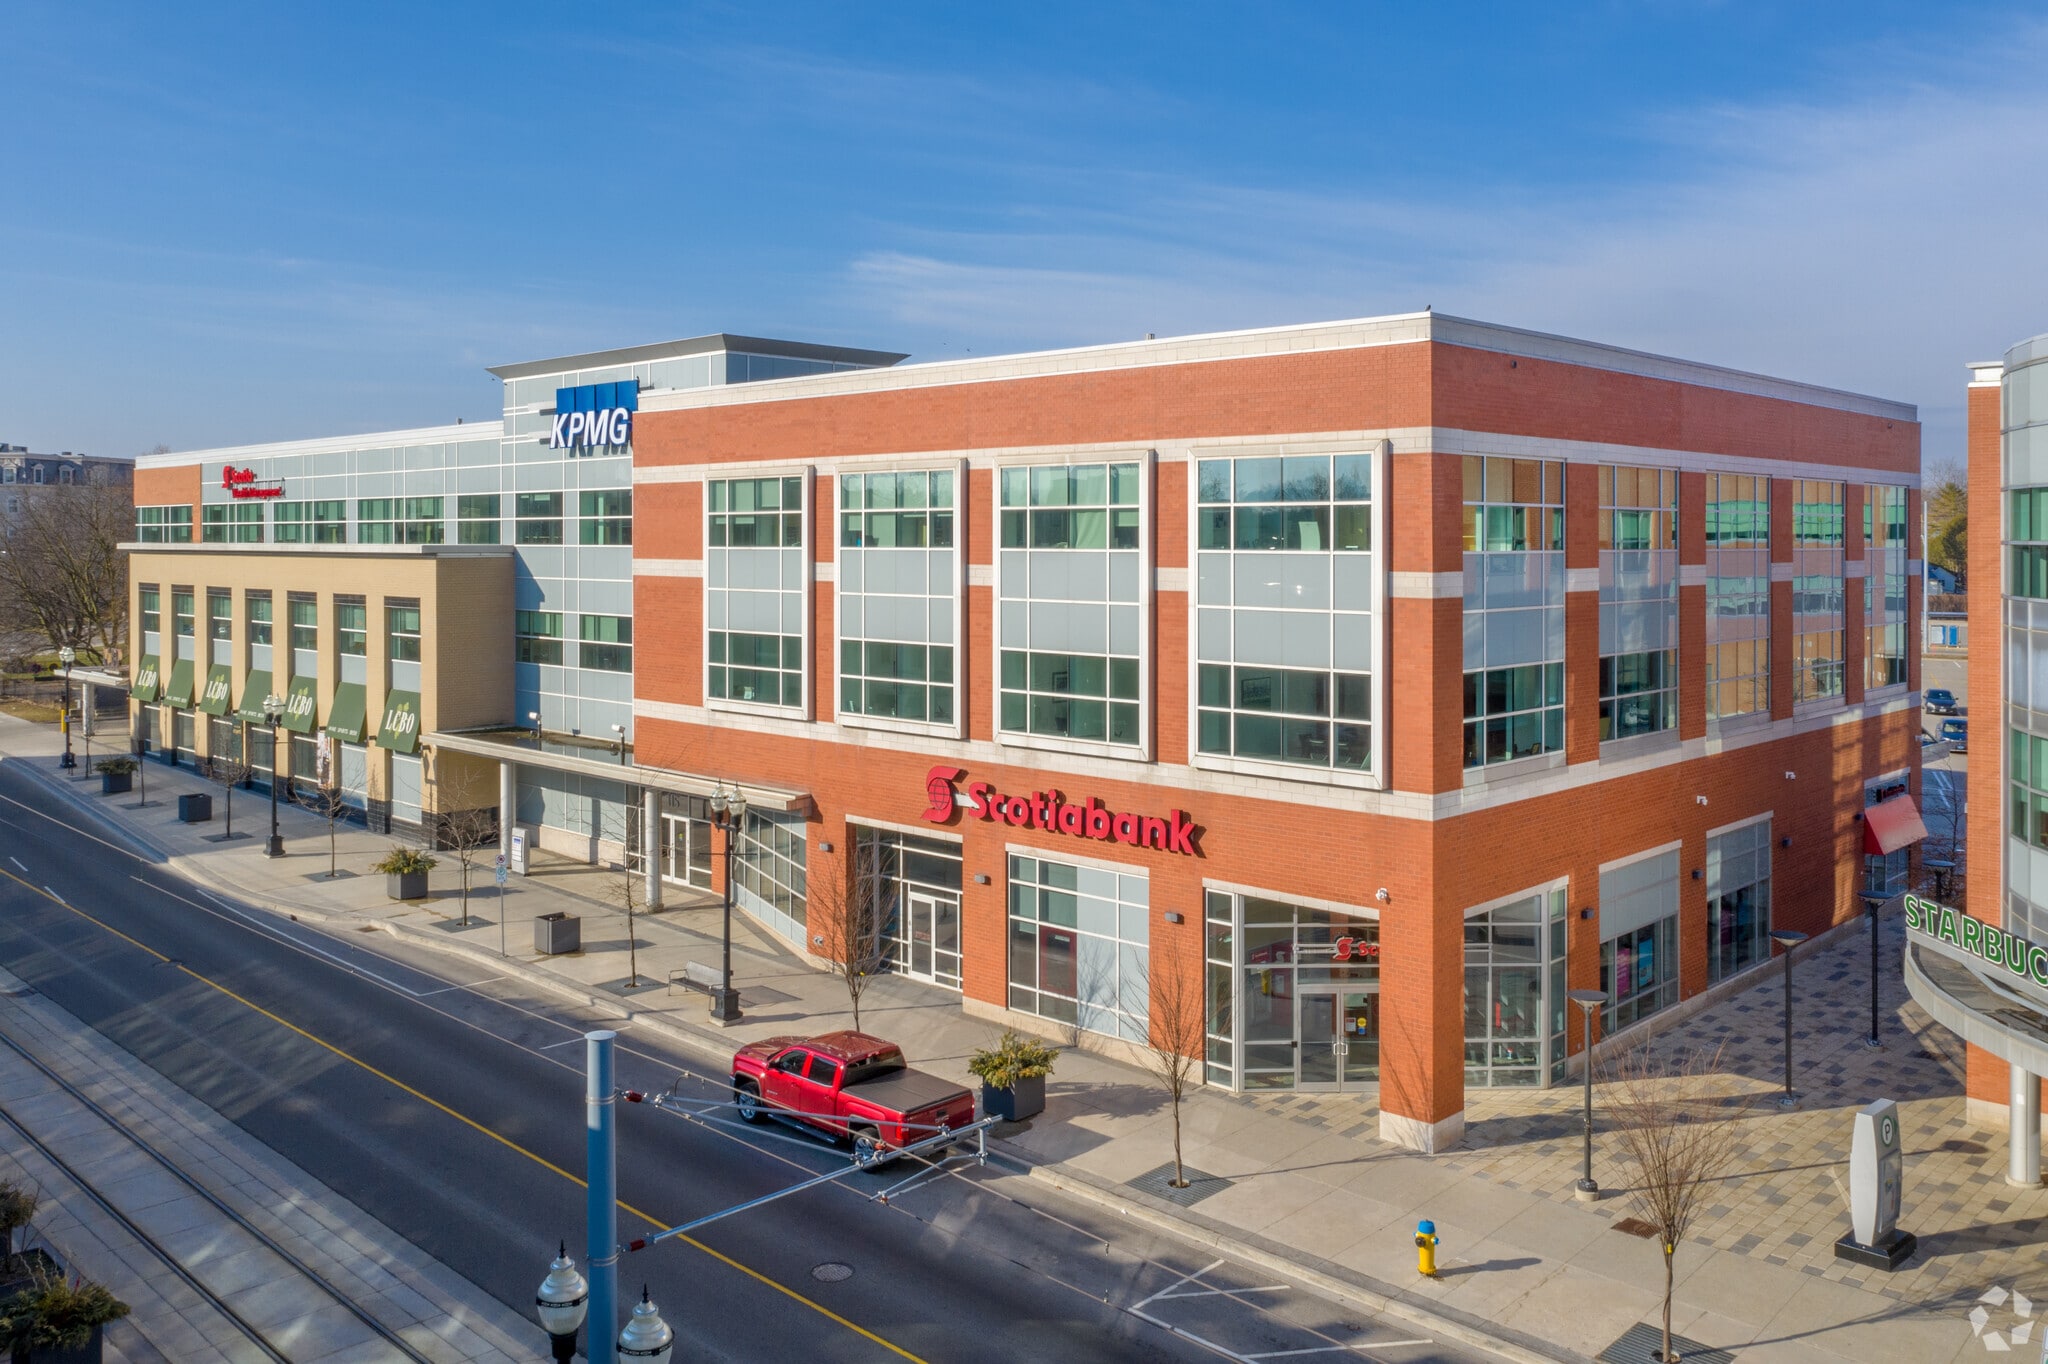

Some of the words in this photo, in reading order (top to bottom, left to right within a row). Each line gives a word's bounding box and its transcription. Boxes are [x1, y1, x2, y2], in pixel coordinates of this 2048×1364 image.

[550, 407, 630, 449] KPMG
[137, 669, 158, 688] LCBO
[206, 681, 229, 701] LCBO
[287, 694, 313, 716] LCBO
[385, 709, 415, 734] LCBO
[968, 781, 1198, 854] Scotiabank
[1904, 894, 2048, 987] STARBUC
